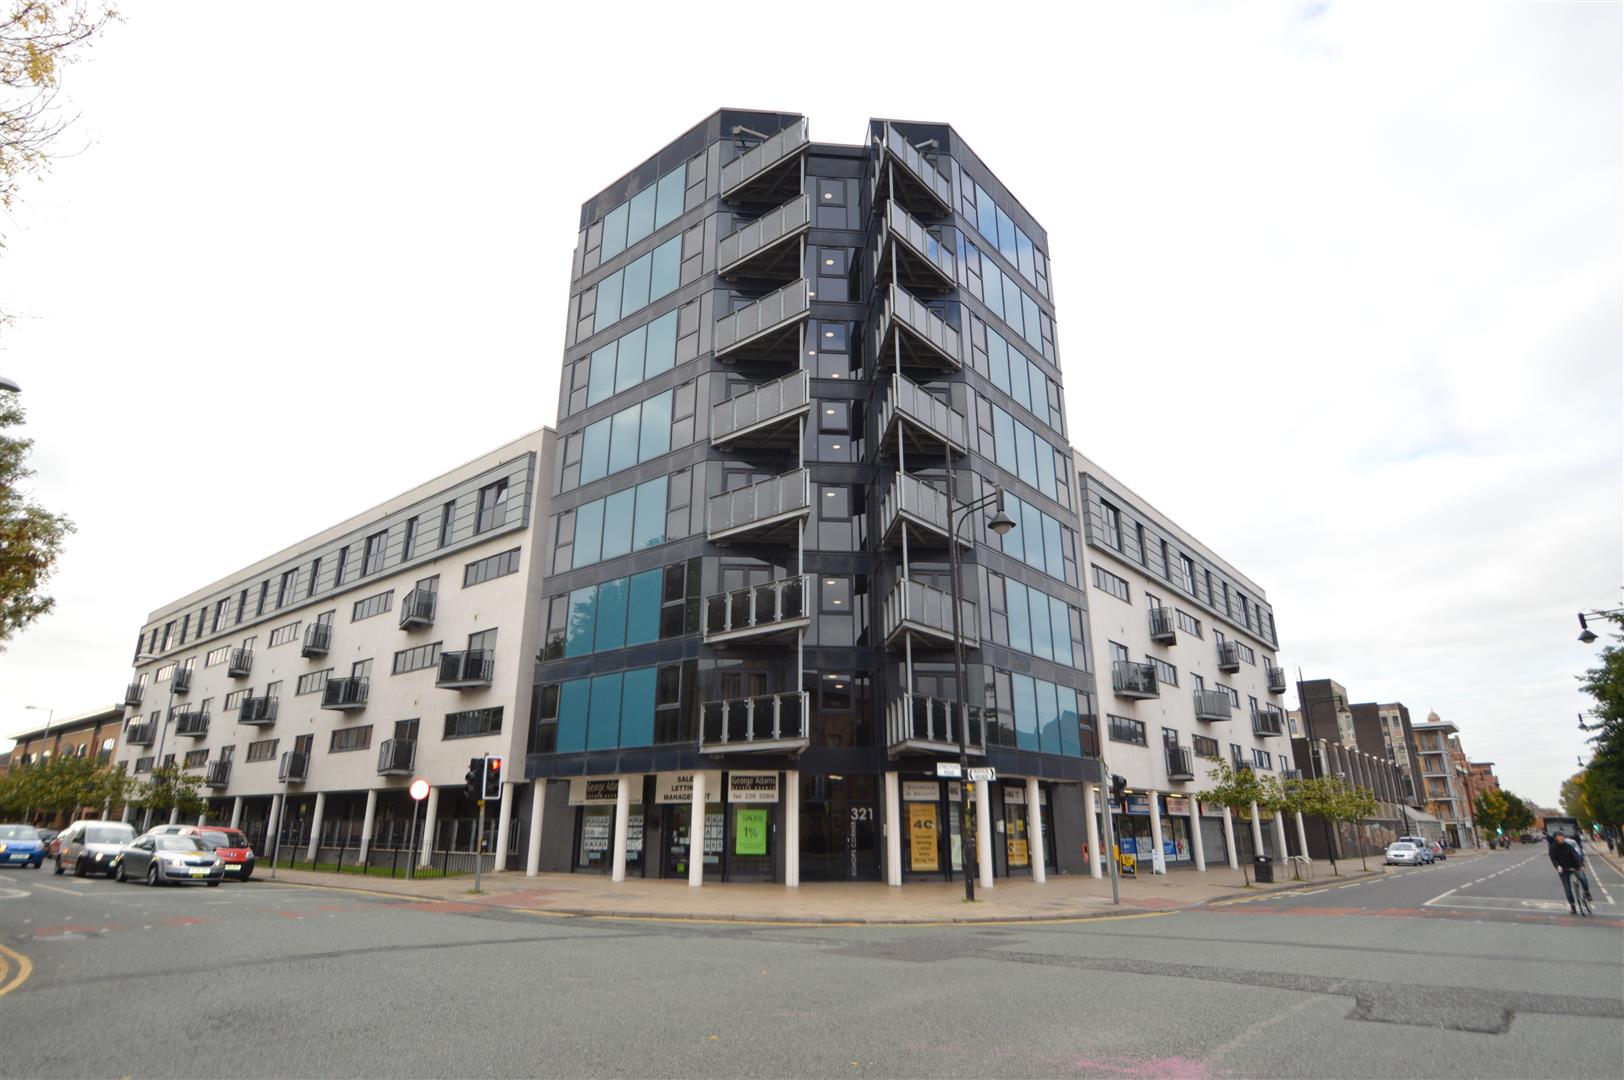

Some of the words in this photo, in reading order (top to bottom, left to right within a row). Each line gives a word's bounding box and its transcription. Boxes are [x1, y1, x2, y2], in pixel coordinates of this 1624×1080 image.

[677, 775, 694, 783] SALE
[671, 784, 693, 792] LETTIN
[663, 792, 711, 801] MANAGET
[851, 808, 873, 820] 321
